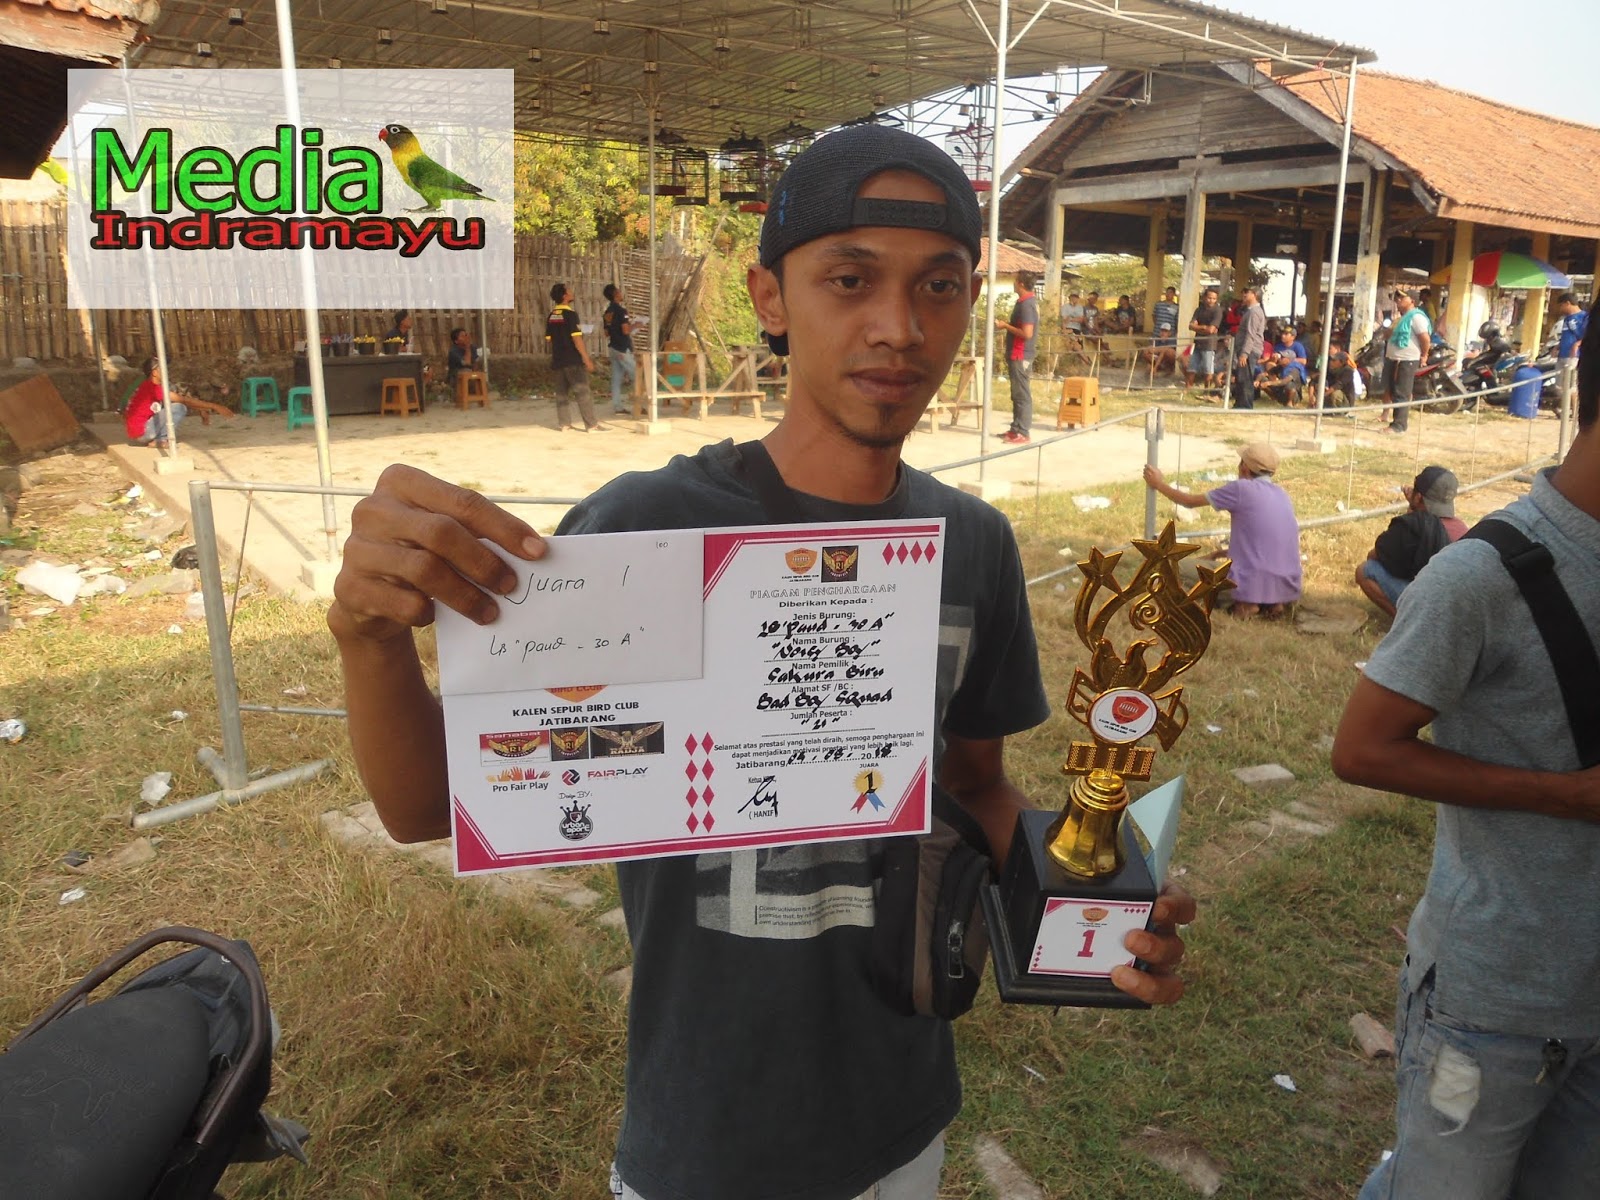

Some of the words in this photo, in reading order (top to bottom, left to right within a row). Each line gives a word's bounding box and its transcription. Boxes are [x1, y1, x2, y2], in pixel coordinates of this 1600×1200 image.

[750, 589, 800, 599] PIAGAM
[803, 583, 897, 597] PENGHARGAAN
[779, 600, 827, 608] Diberikan
[830, 598, 867, 607] Kepada
[792, 613, 817, 621] Jenis
[792, 637, 817, 646] Nama
[819, 636, 850, 645] Burung
[792, 662, 816, 670] Nama
[818, 660, 849, 669] Pemilik
[791, 685, 819, 694] Alamat
[821, 684, 832, 692] SF
[512, 708, 547, 717] KALEN
[551, 705, 583, 715] SEPUR
[587, 703, 611, 712] BIRD
[615, 701, 640, 710] CLUB
[790, 711, 818, 720] Jumlah
[820, 710, 848, 718] Peserta
[539, 714, 616, 727] JATIBARANG
[714, 743, 741, 751] Selamat
[759, 740, 785, 749] prestasi
[872, 731, 915, 741] penghargaan
[731, 751, 751, 759] dapat
[752, 748, 791, 758] menjadikan
[793, 746, 820, 754] motivasi
[822, 744, 848, 752] prestasi
[850, 743, 865, 751] yang
[867, 741, 883, 749] lebih
[587, 767, 648, 778] FAIRPLAY
[493, 784, 508, 792] Pro
[510, 782, 527, 791] Fair
[529, 780, 549, 791] Play
[862, 772, 877, 797] 1
[1077, 930, 1096, 958] 1
